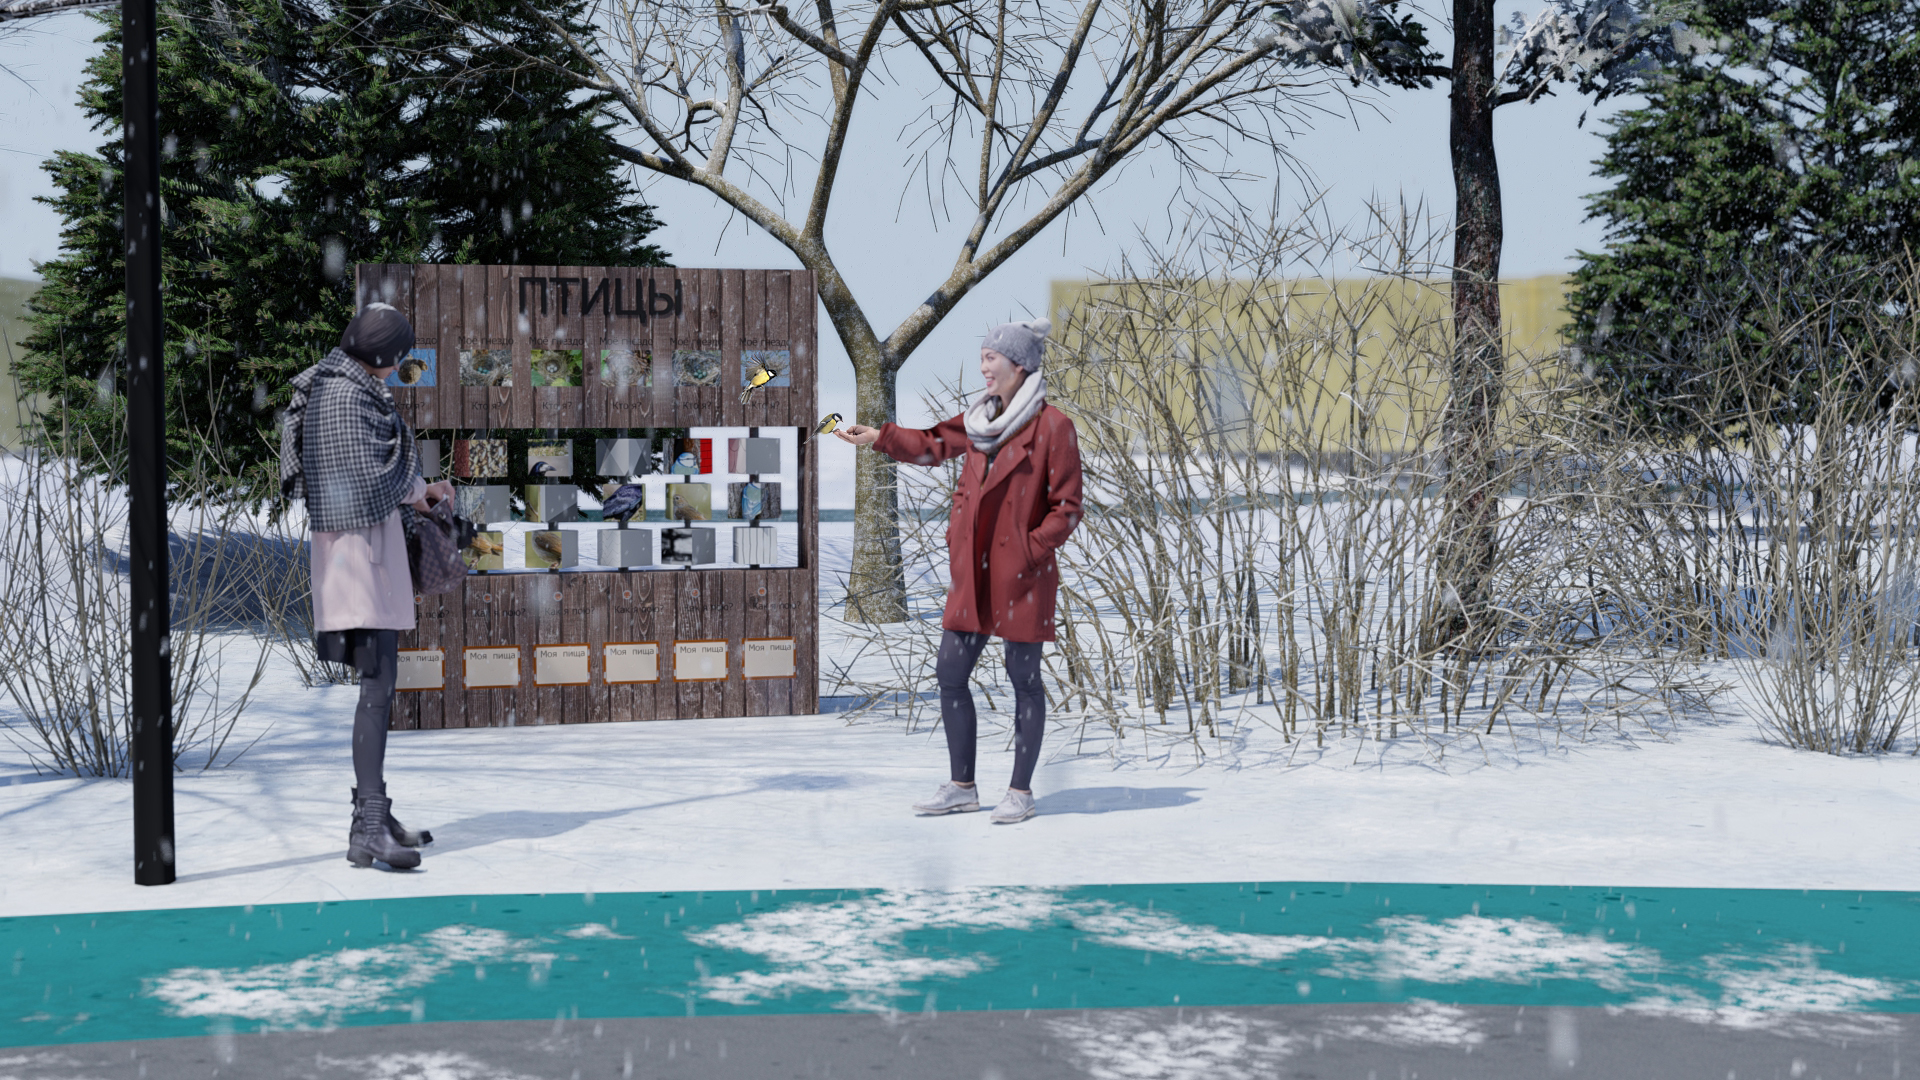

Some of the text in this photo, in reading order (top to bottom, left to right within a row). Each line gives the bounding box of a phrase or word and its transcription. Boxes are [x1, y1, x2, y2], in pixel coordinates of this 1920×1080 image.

[519, 277, 683, 324] ПТИЦЫ
[459, 336, 514, 346] Моё гнездо
[529, 336, 549, 346] Моё
[670, 337, 689, 346] Моё
[740, 337, 759, 347] Моё
[395, 402, 425, 410] Кто я?
[472, 402, 502, 410] Кто я?
[543, 402, 572, 410] Кто я?
[613, 402, 642, 410] Кто я?
[683, 402, 712, 410] Кто я?
[752, 401, 780, 410] Кто я?
[610, 648, 655, 656] Моя пища
[680, 645, 724, 654] Моя пища
[749, 643, 792, 652] Моя пища
[416, 654, 440, 662] пища
[470, 652, 516, 661] Моя пища
[540, 650, 586, 659] Моя пища
